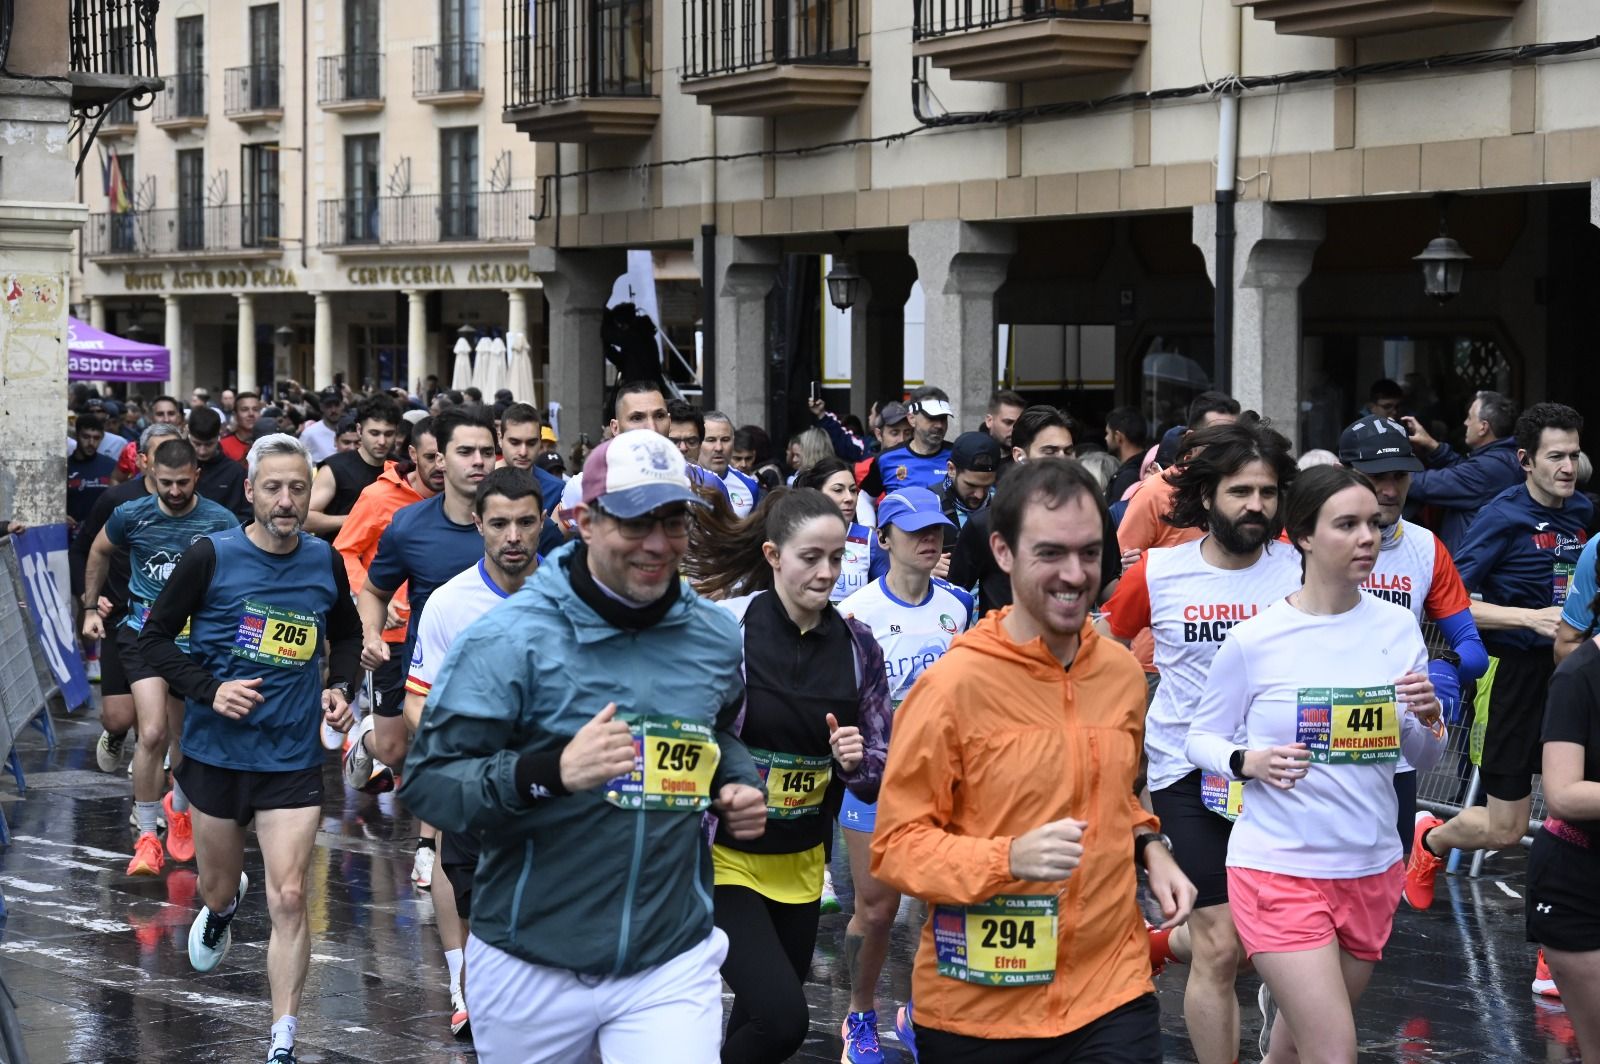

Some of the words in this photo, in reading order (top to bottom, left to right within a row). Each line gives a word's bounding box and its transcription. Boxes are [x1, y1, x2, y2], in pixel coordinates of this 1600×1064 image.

[252, 267, 297, 287] PLAZA
[348, 264, 455, 285] CERVECERIA
[272, 623, 308, 646] 205
[278, 646, 296, 657] Peña
[885, 652, 946, 678] arre
[1301, 708, 1329, 722] 10K
[1347, 707, 1382, 732] 441
[1332, 736, 1397, 748] ANGELANISTAL
[656, 741, 702, 772] 295
[782, 772, 816, 792] 145
[1202, 790, 1228, 798] ASTORGA
[1006, 900, 1024, 908] CAJA
[981, 919, 1036, 949] 294
[995, 956, 1026, 968] Efrén
[1005, 974, 1024, 983] CAJA
